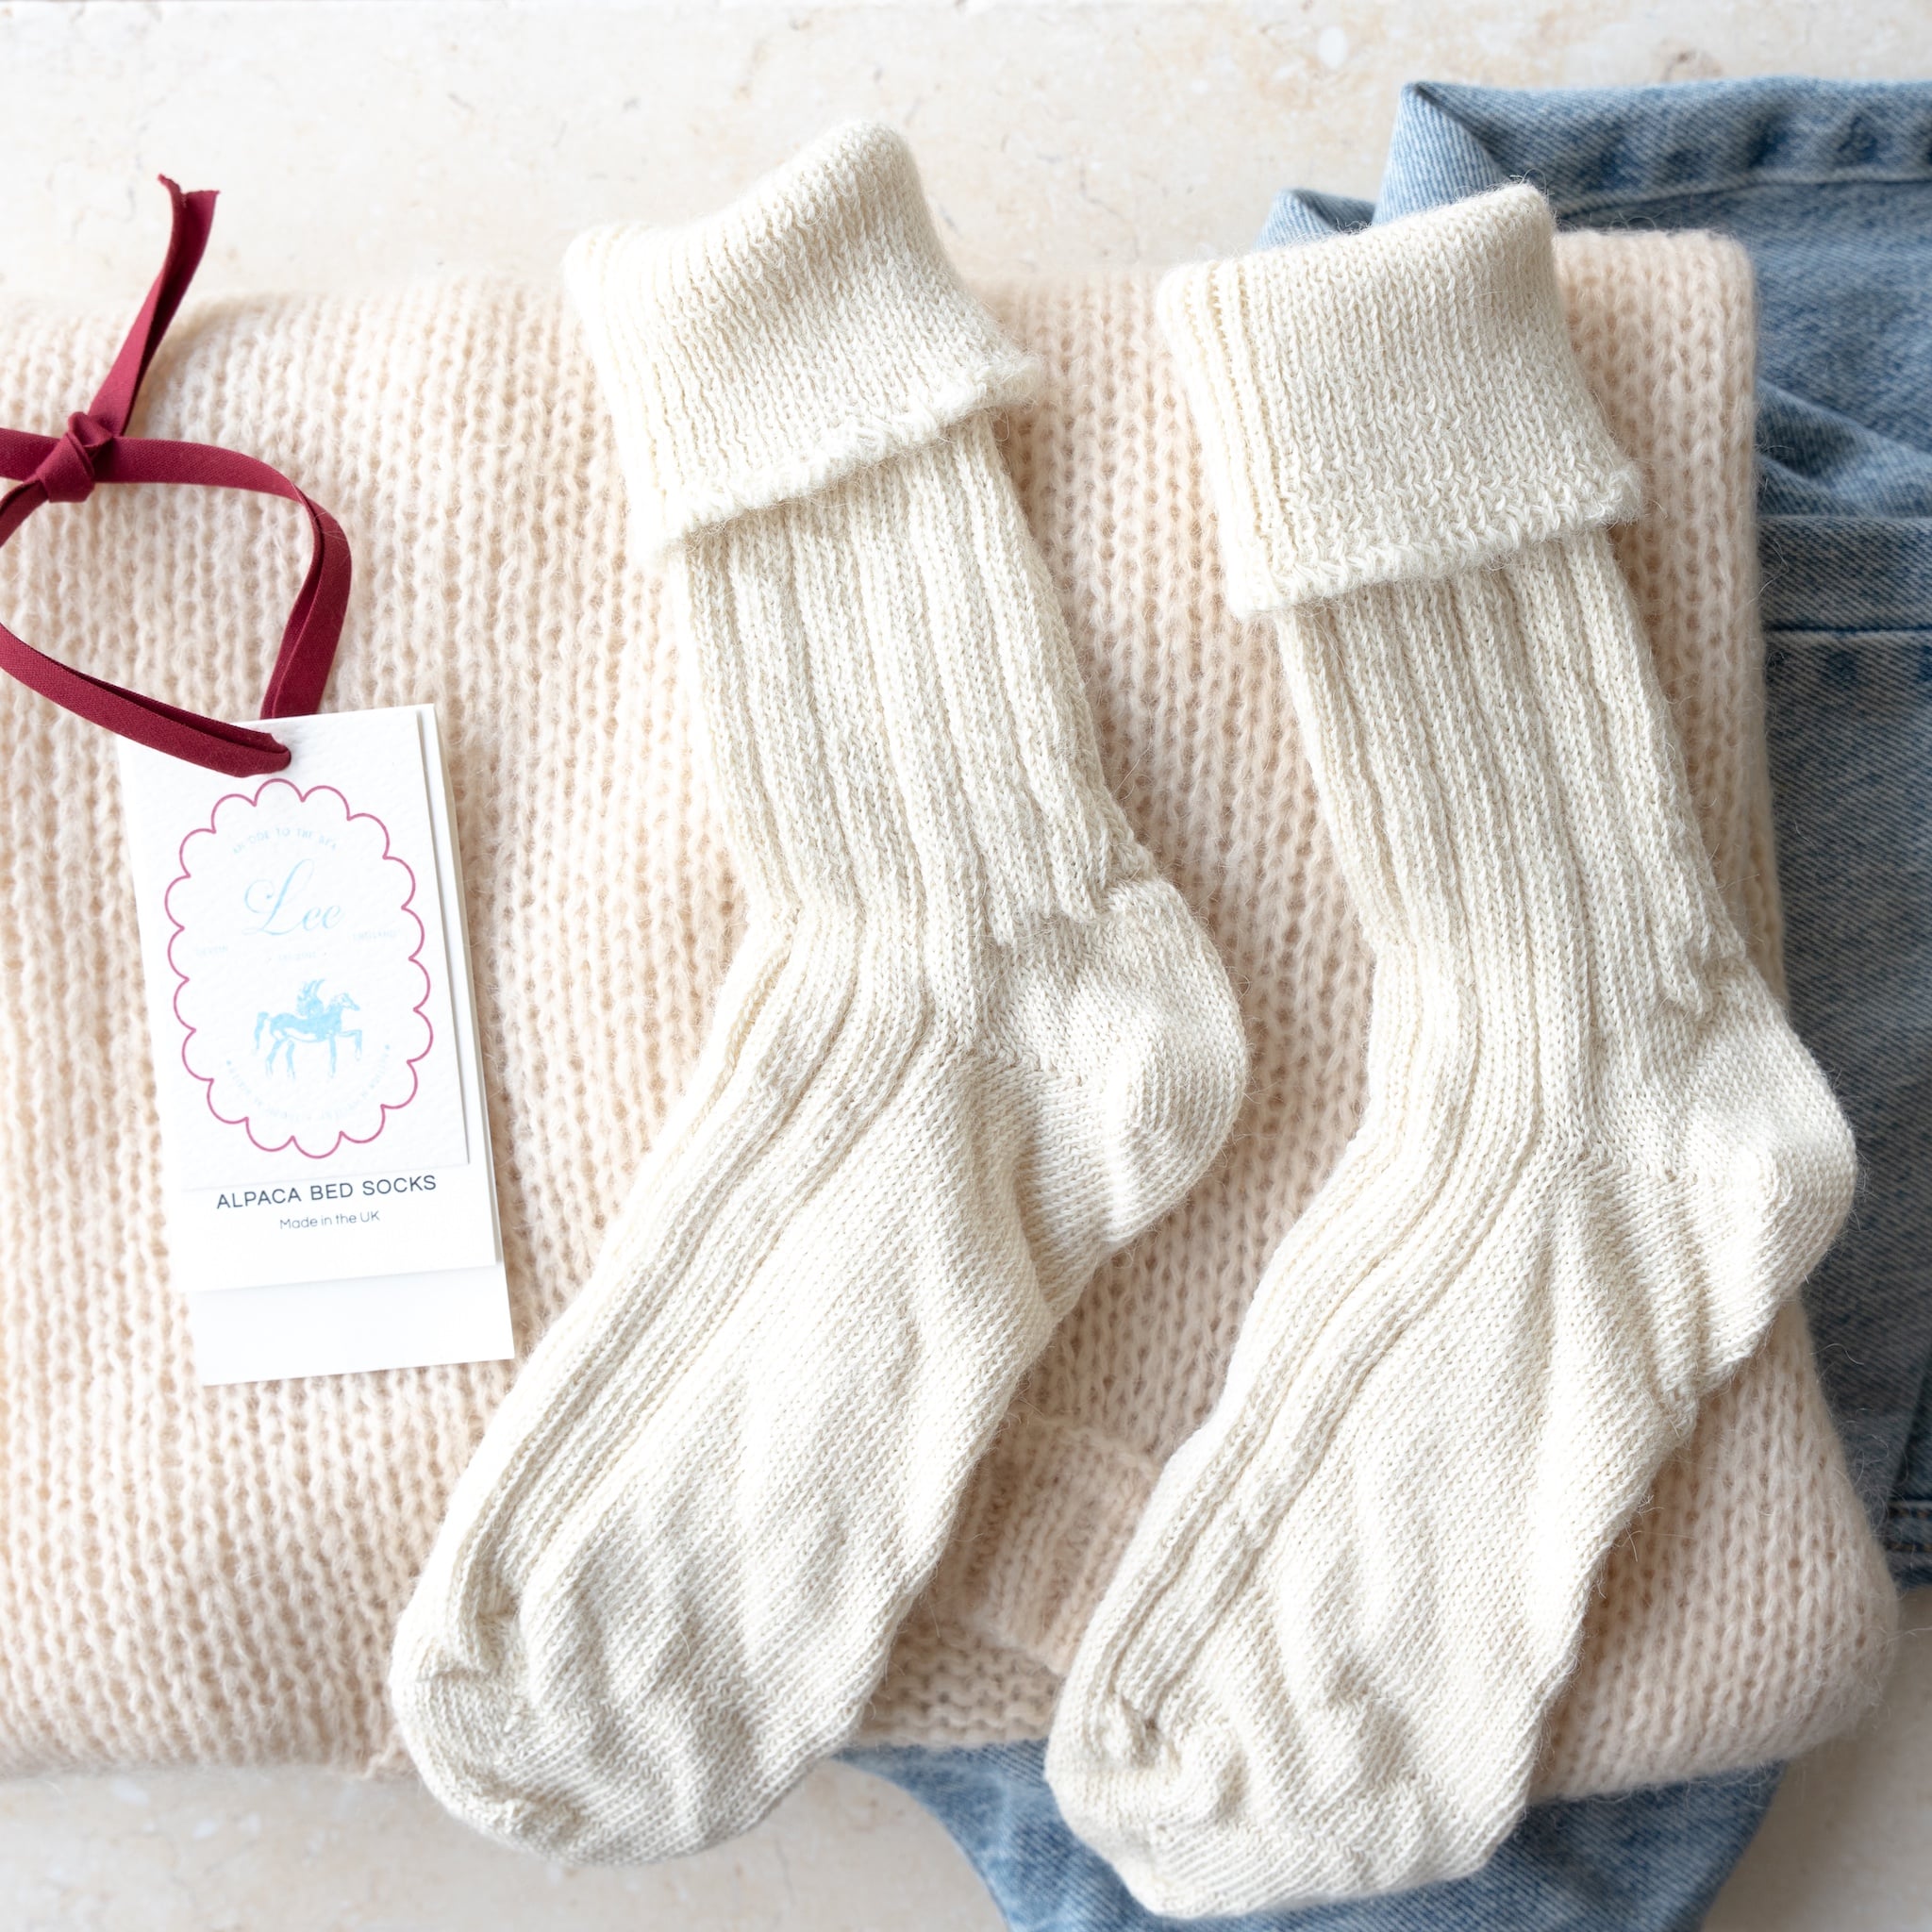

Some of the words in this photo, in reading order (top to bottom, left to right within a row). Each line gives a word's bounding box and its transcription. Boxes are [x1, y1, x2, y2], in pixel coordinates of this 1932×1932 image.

[242, 858, 345, 936] Lee
[217, 1188, 302, 1208] ALPACA
[310, 1183, 353, 1200] BED
[362, 1175, 436, 1195] SOCKS
[279, 1217, 318, 1230] Made
[321, 1215, 333, 1226] in
[336, 1212, 358, 1224] the
[360, 1209, 380, 1224] UK
